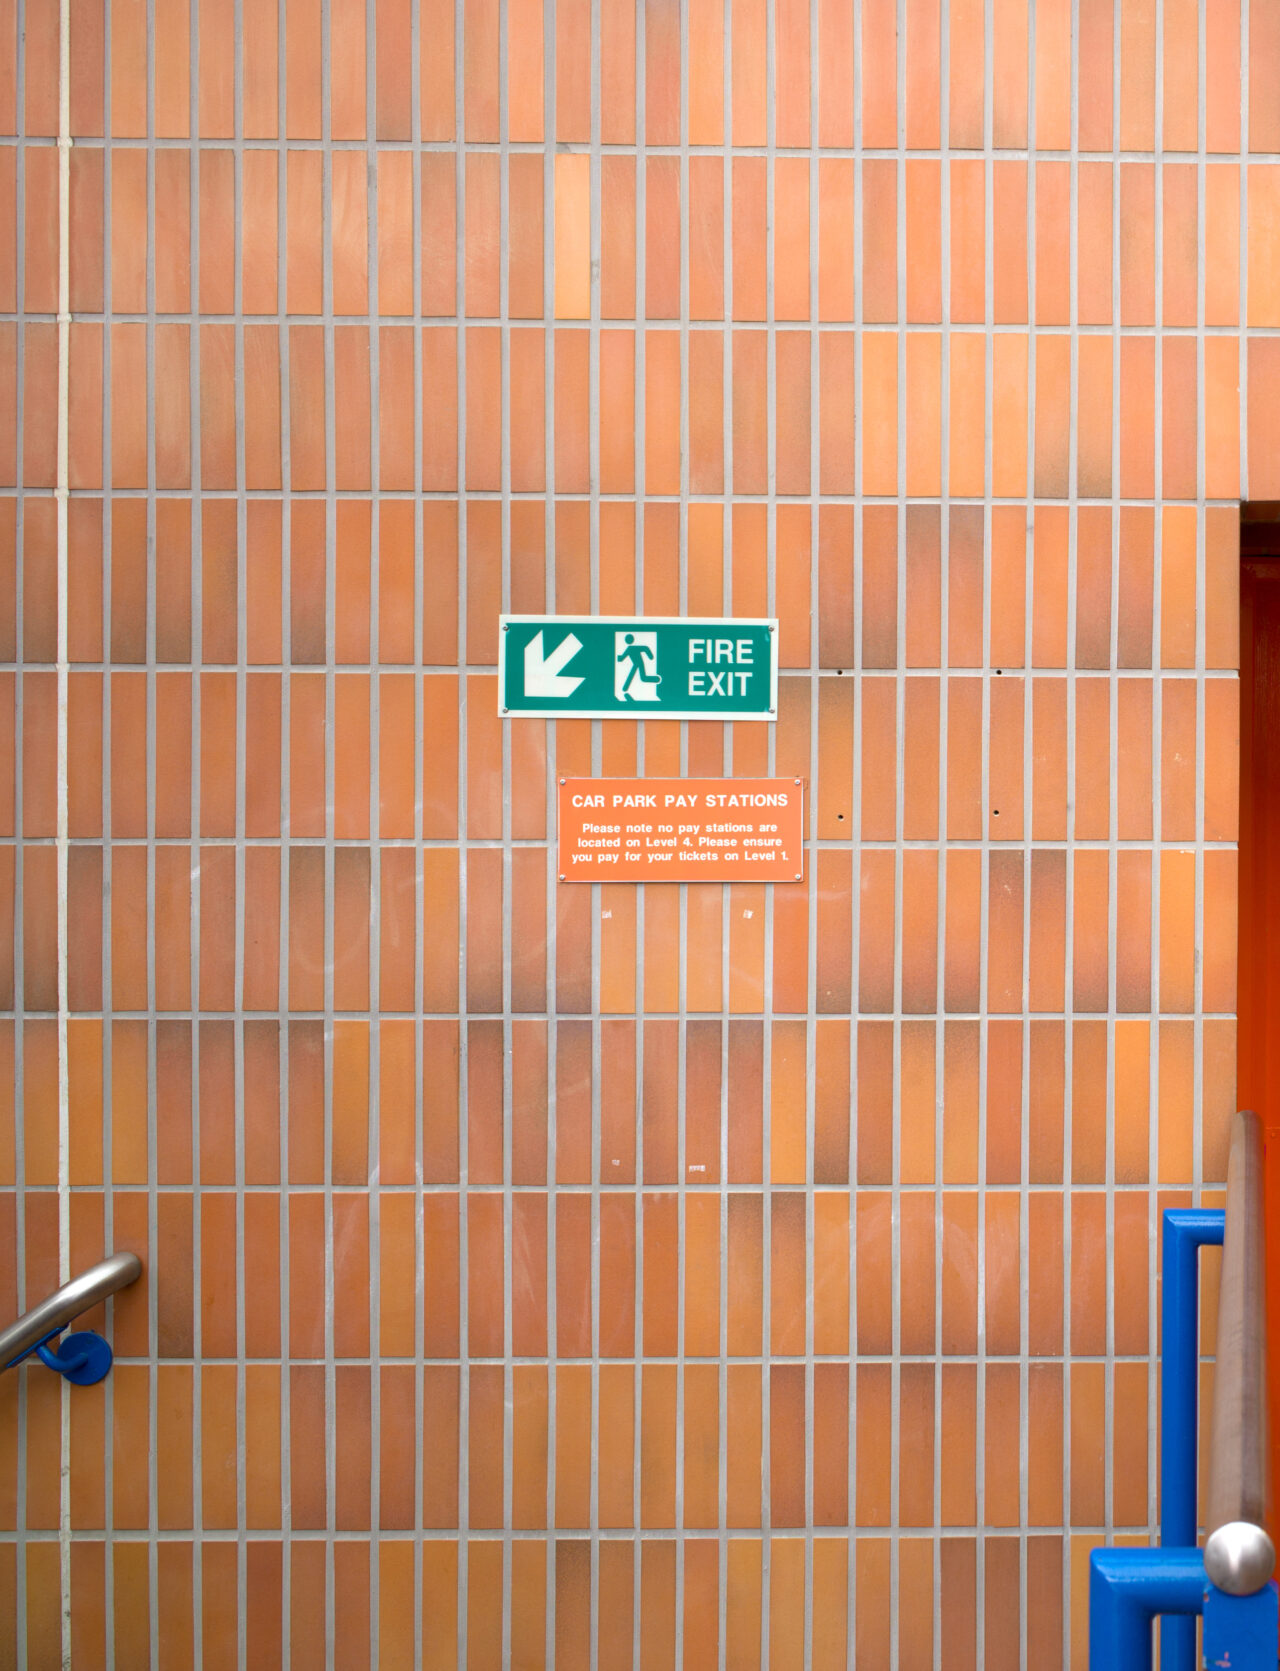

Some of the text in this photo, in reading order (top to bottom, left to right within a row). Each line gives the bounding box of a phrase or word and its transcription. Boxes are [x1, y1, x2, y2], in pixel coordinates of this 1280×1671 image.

[688, 639, 754, 664] FIRE
[688, 671, 753, 697] EXIT
[572, 794, 788, 807] CAR PARK PAY STATIONS
[582, 823, 778, 835] Please note no pay stations are
[578, 837, 782, 847] located on Level 4. Please ensure
[572, 851, 789, 864] you pay for your tickets on Level 1.
